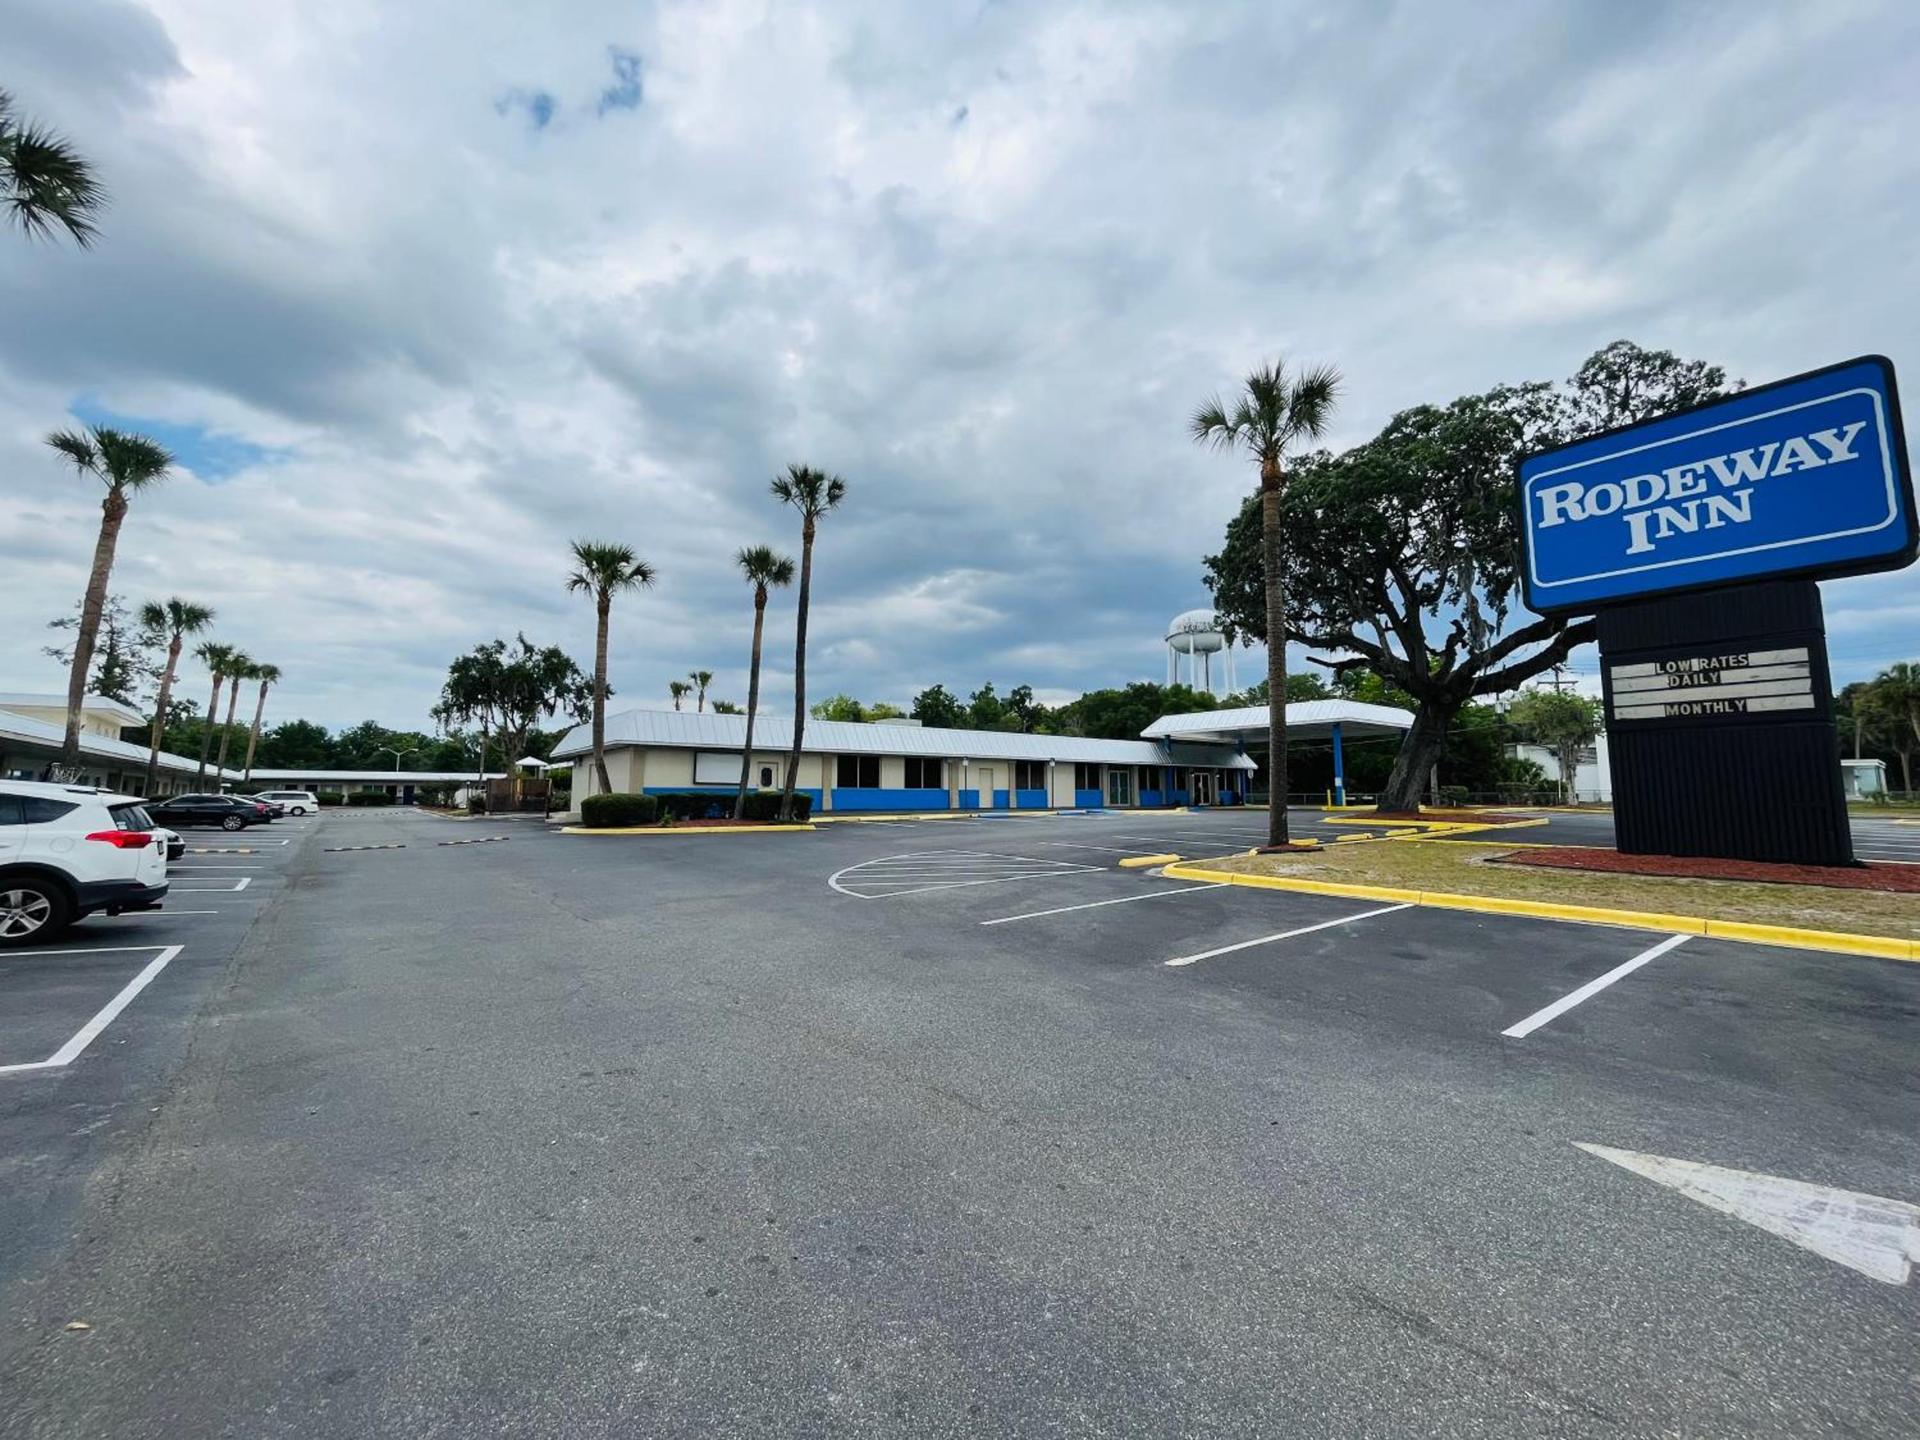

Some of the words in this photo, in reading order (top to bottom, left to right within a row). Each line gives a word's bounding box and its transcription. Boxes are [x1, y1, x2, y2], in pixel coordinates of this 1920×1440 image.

[1535, 421, 1866, 528] RODEWAY
[1623, 488, 1754, 555] INN
[1656, 660, 1691, 673] LOW
[1699, 654, 1747, 669] RATES
[1670, 672, 1719, 686] DAILY
[1665, 700, 1745, 715] MONTHLY
